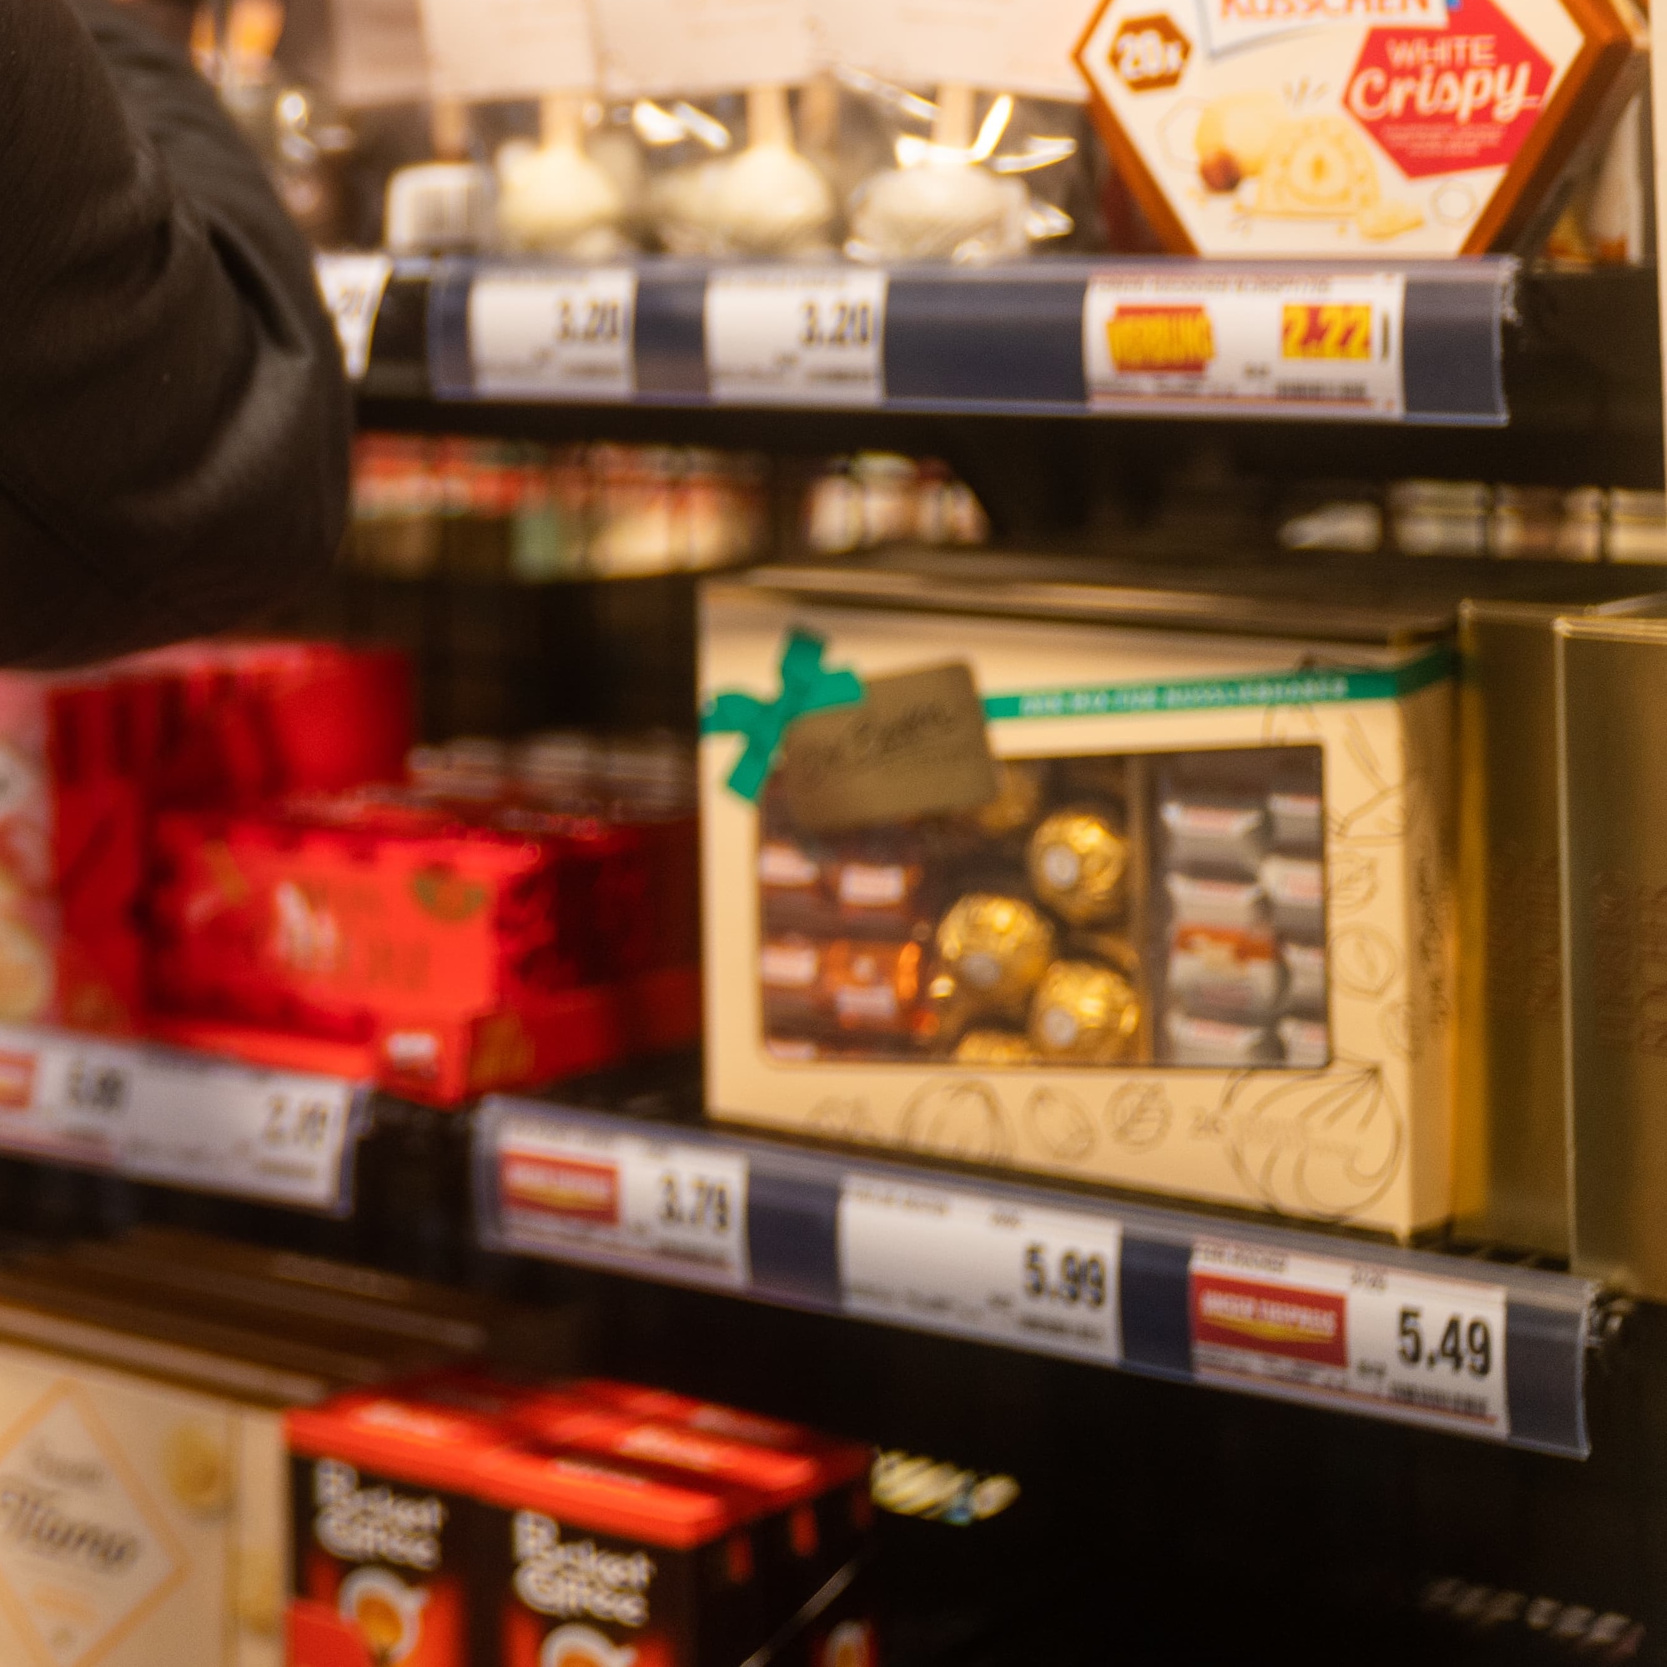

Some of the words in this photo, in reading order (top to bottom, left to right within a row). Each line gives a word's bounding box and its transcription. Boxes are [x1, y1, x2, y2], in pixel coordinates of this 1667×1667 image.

[1386, 35, 1497, 67] WHITE
[1348, 64, 1542, 124] Crispy
[799, 300, 874, 347] 3.20
[1024, 1241, 1106, 1307] 5.99
[1397, 1307, 1491, 1377] 5.49
